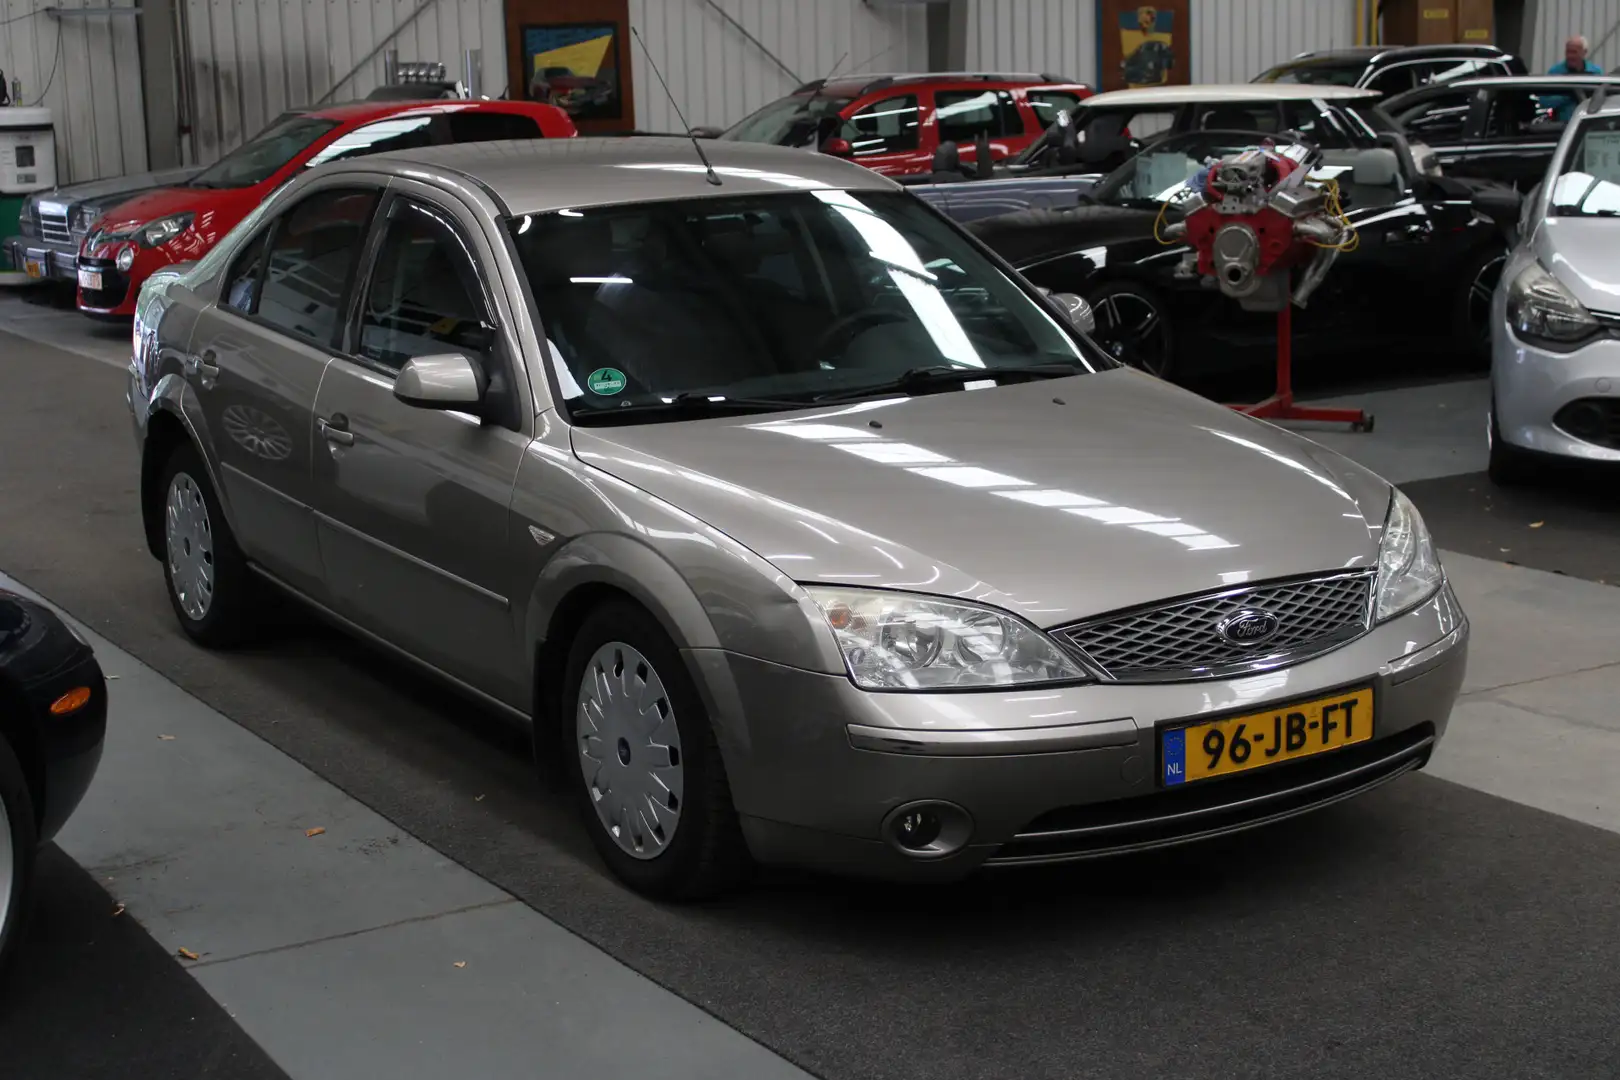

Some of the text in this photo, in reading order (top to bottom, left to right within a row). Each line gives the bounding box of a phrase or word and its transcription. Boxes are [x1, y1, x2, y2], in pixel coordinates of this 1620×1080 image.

[601, 370, 612, 381] 4
[1236, 618, 1268, 638] Ford
[1202, 698, 1359, 770] 96-JB-FT
[1166, 762, 1183, 776] NL
